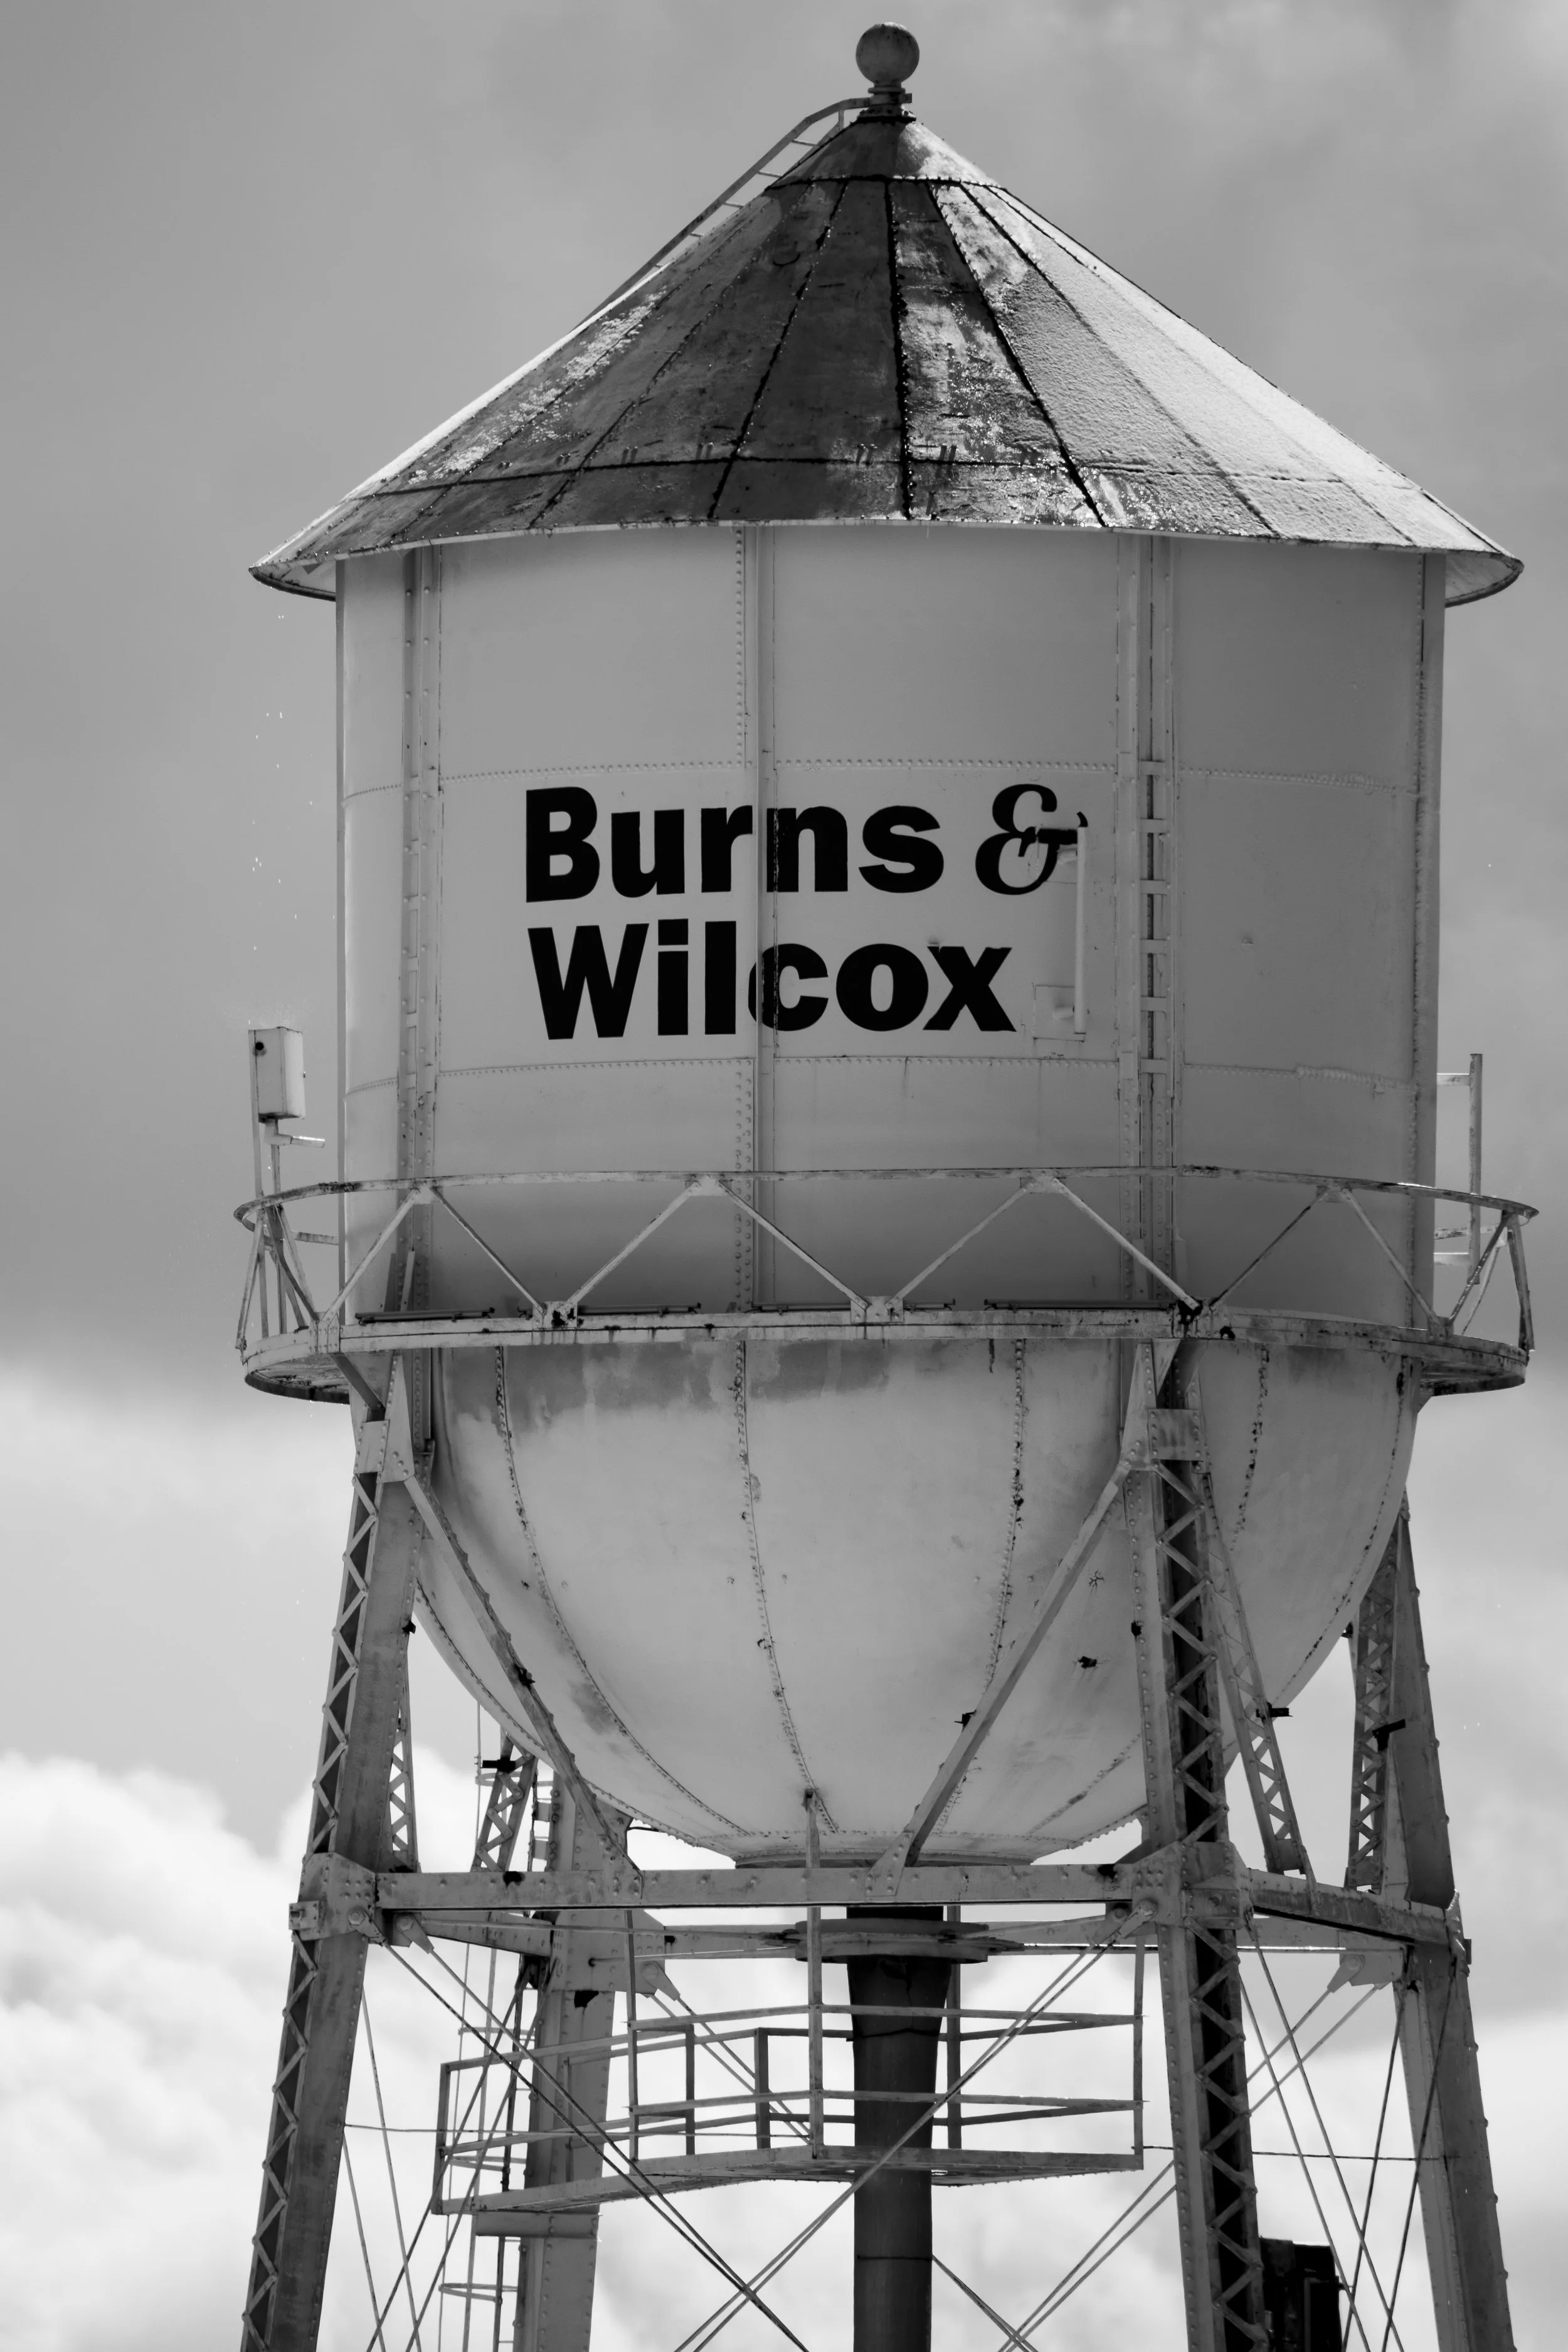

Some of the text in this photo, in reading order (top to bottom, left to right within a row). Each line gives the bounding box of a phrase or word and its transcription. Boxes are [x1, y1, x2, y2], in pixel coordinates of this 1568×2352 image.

[526, 783, 1088, 903] Burns &
[527, 918, 1017, 1040] Wilcox
